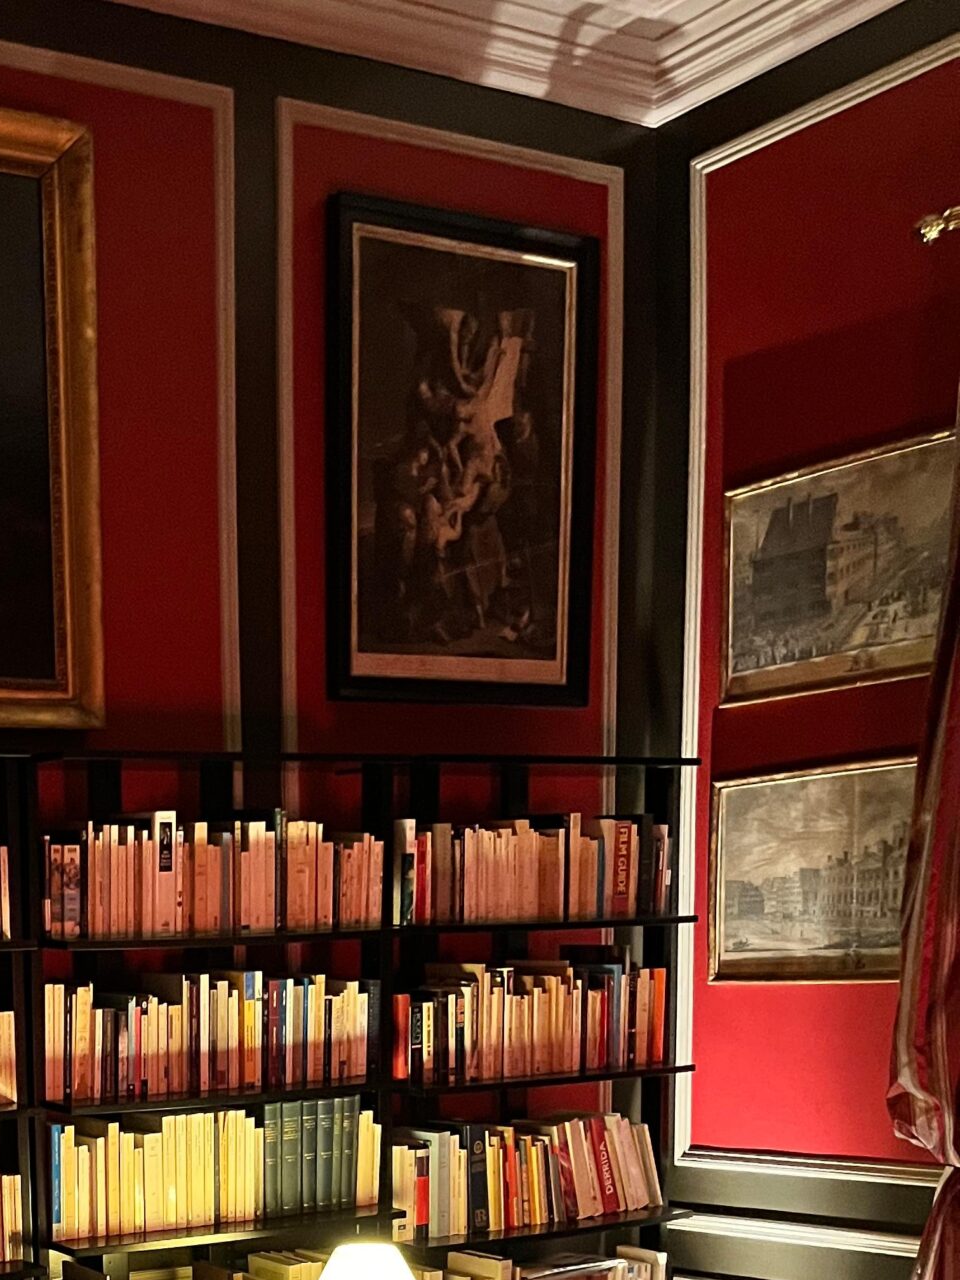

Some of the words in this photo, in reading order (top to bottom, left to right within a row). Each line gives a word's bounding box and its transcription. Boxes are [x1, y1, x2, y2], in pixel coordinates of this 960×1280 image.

[619, 827, 629, 855] FILM
[617, 857, 628, 893] GUIDE
[599, 1140, 614, 1196] DERRIDA
